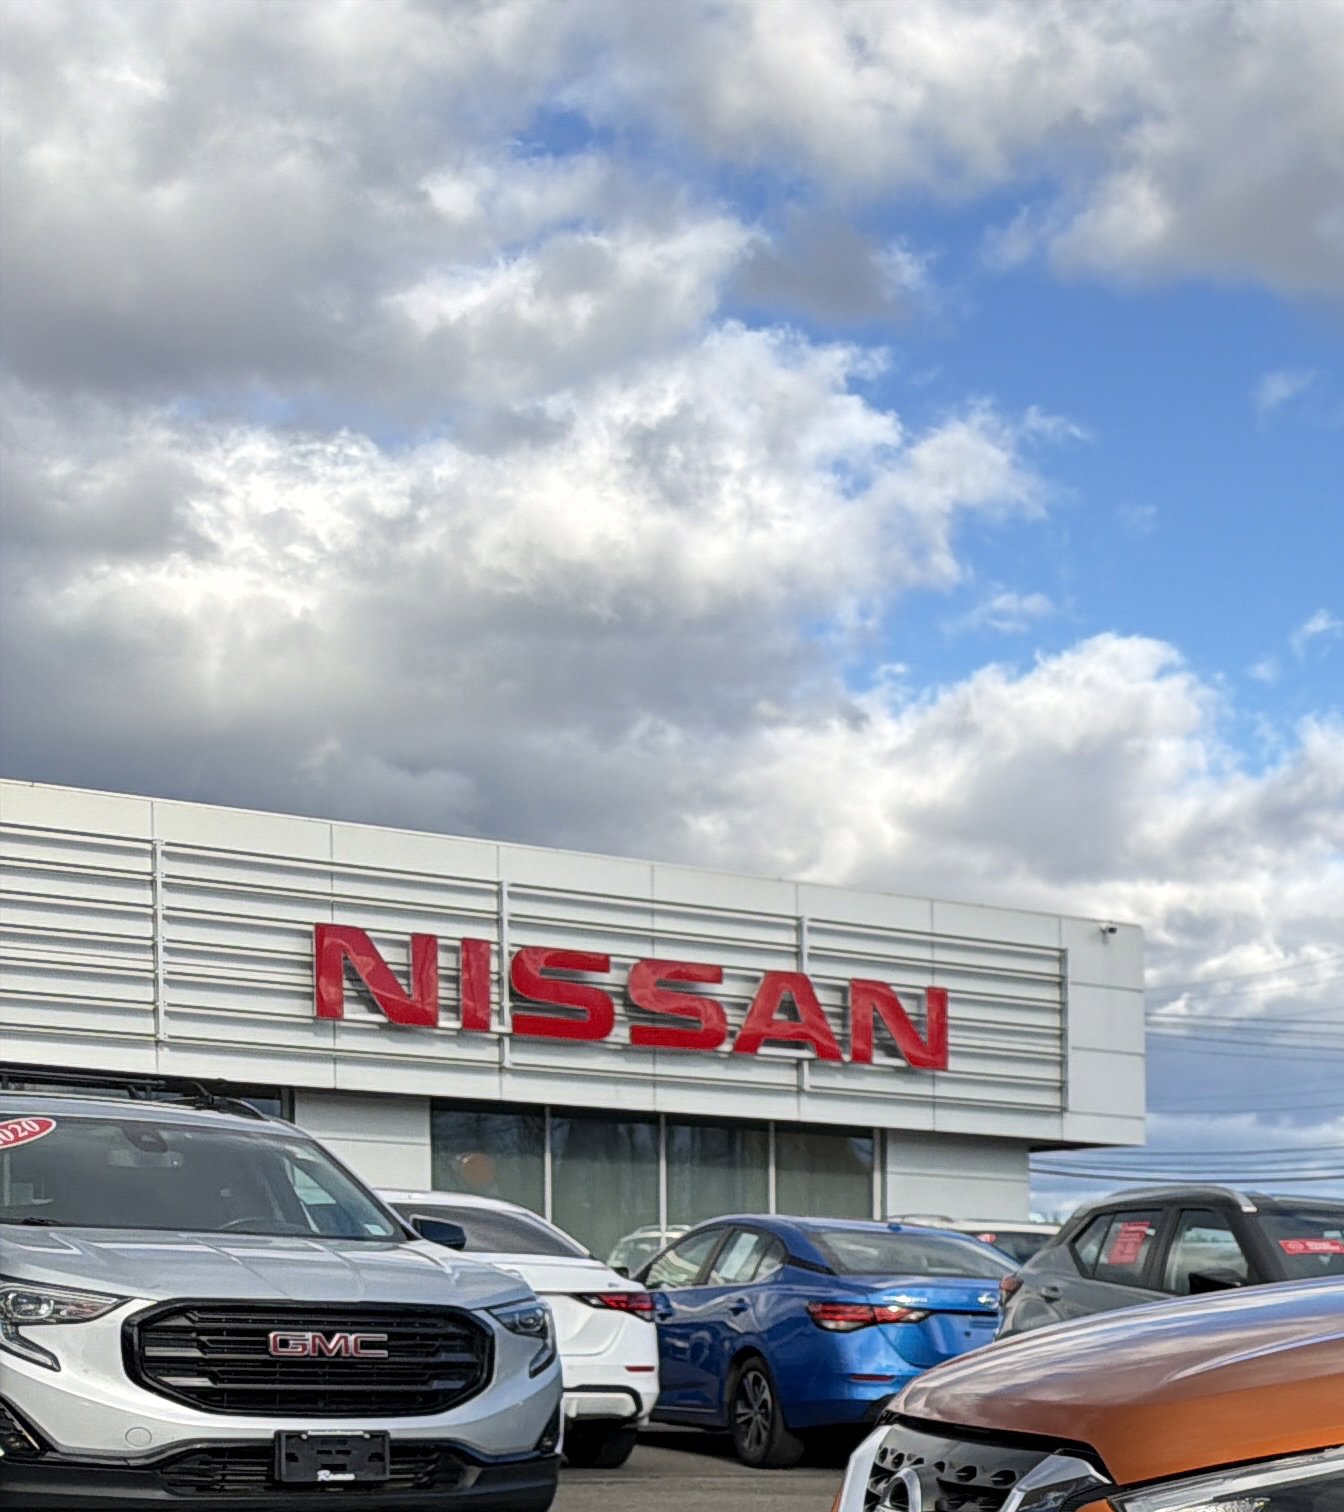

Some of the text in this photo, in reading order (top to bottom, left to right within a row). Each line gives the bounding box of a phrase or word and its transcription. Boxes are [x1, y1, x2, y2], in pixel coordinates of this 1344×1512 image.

[314, 922, 949, 1071] NISSAN
[0, 1120, 40, 1144] 020
[268, 1331, 388, 1358] GMC
